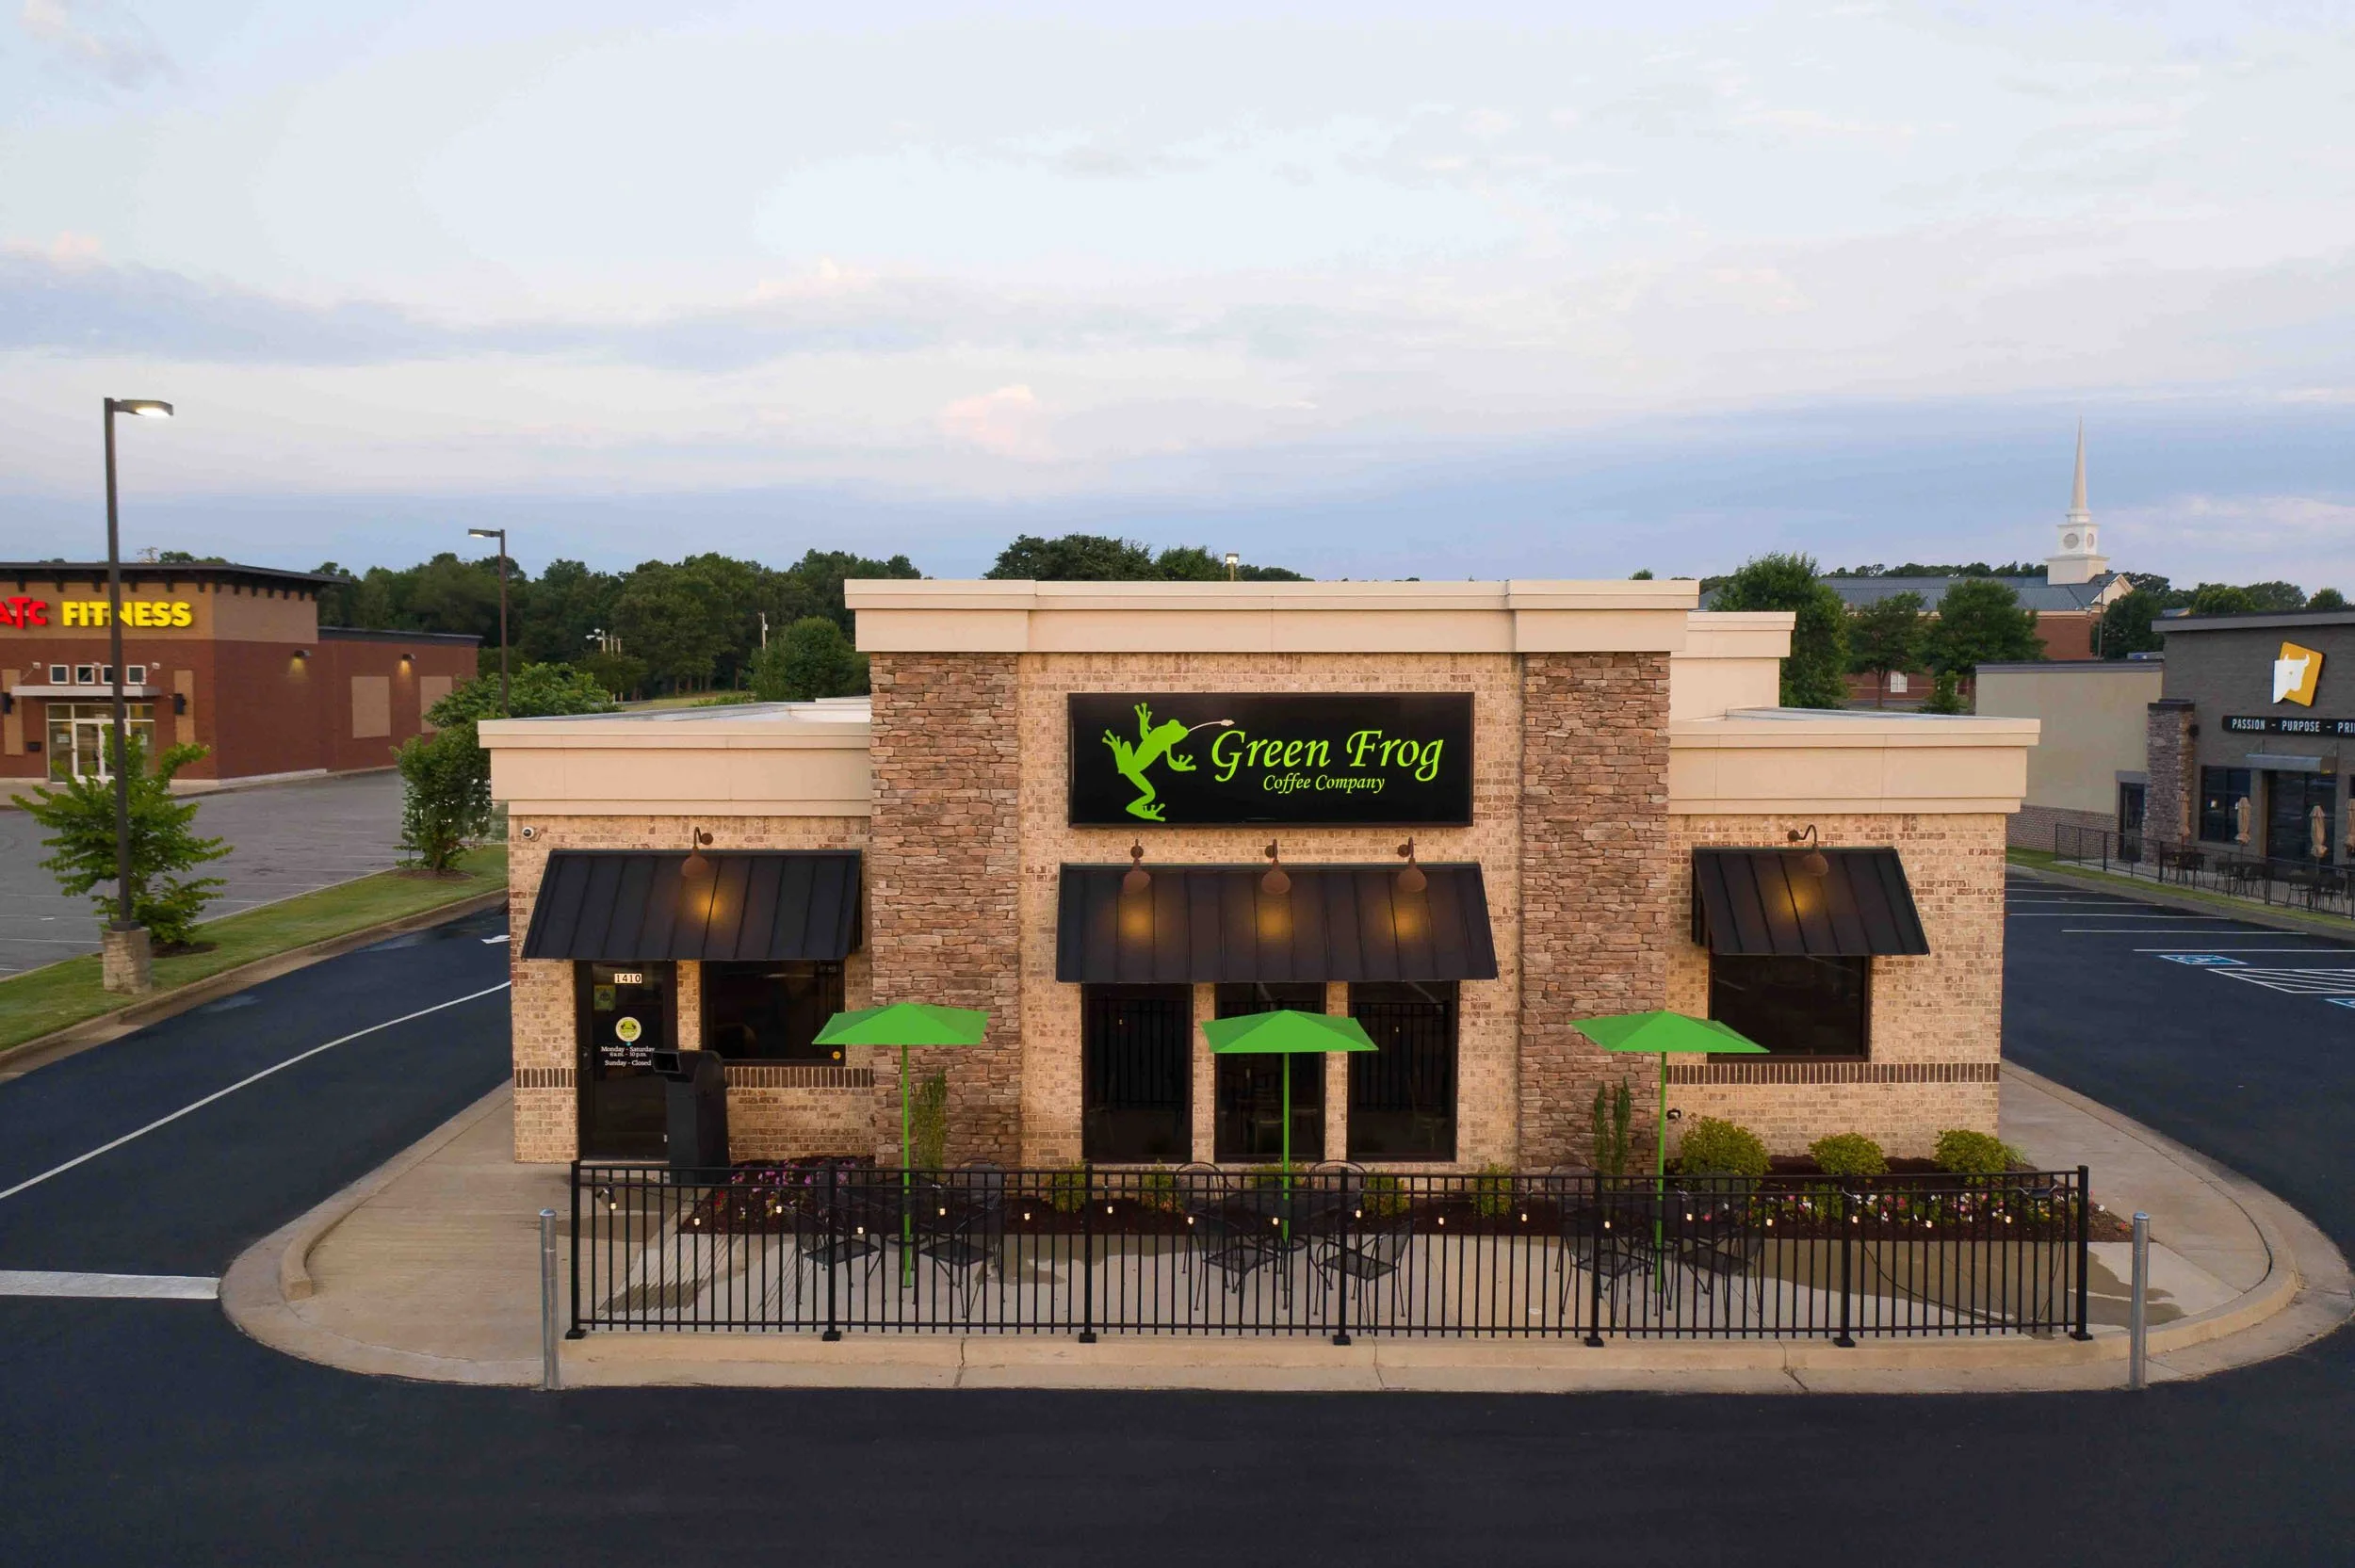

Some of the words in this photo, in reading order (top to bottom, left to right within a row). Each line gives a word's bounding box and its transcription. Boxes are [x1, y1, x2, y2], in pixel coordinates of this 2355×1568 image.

[62, 601, 192, 627] FITNESS
[2232, 719, 2266, 730] PASSION
[2282, 720, 2320, 732] PURPOSE
[2337, 721, 2355, 733] PRI
[1211, 730, 1331, 783] Green
[1345, 730, 1444, 783] Frog
[1263, 773, 1311, 794] Coffee
[1315, 774, 1386, 794] Company
